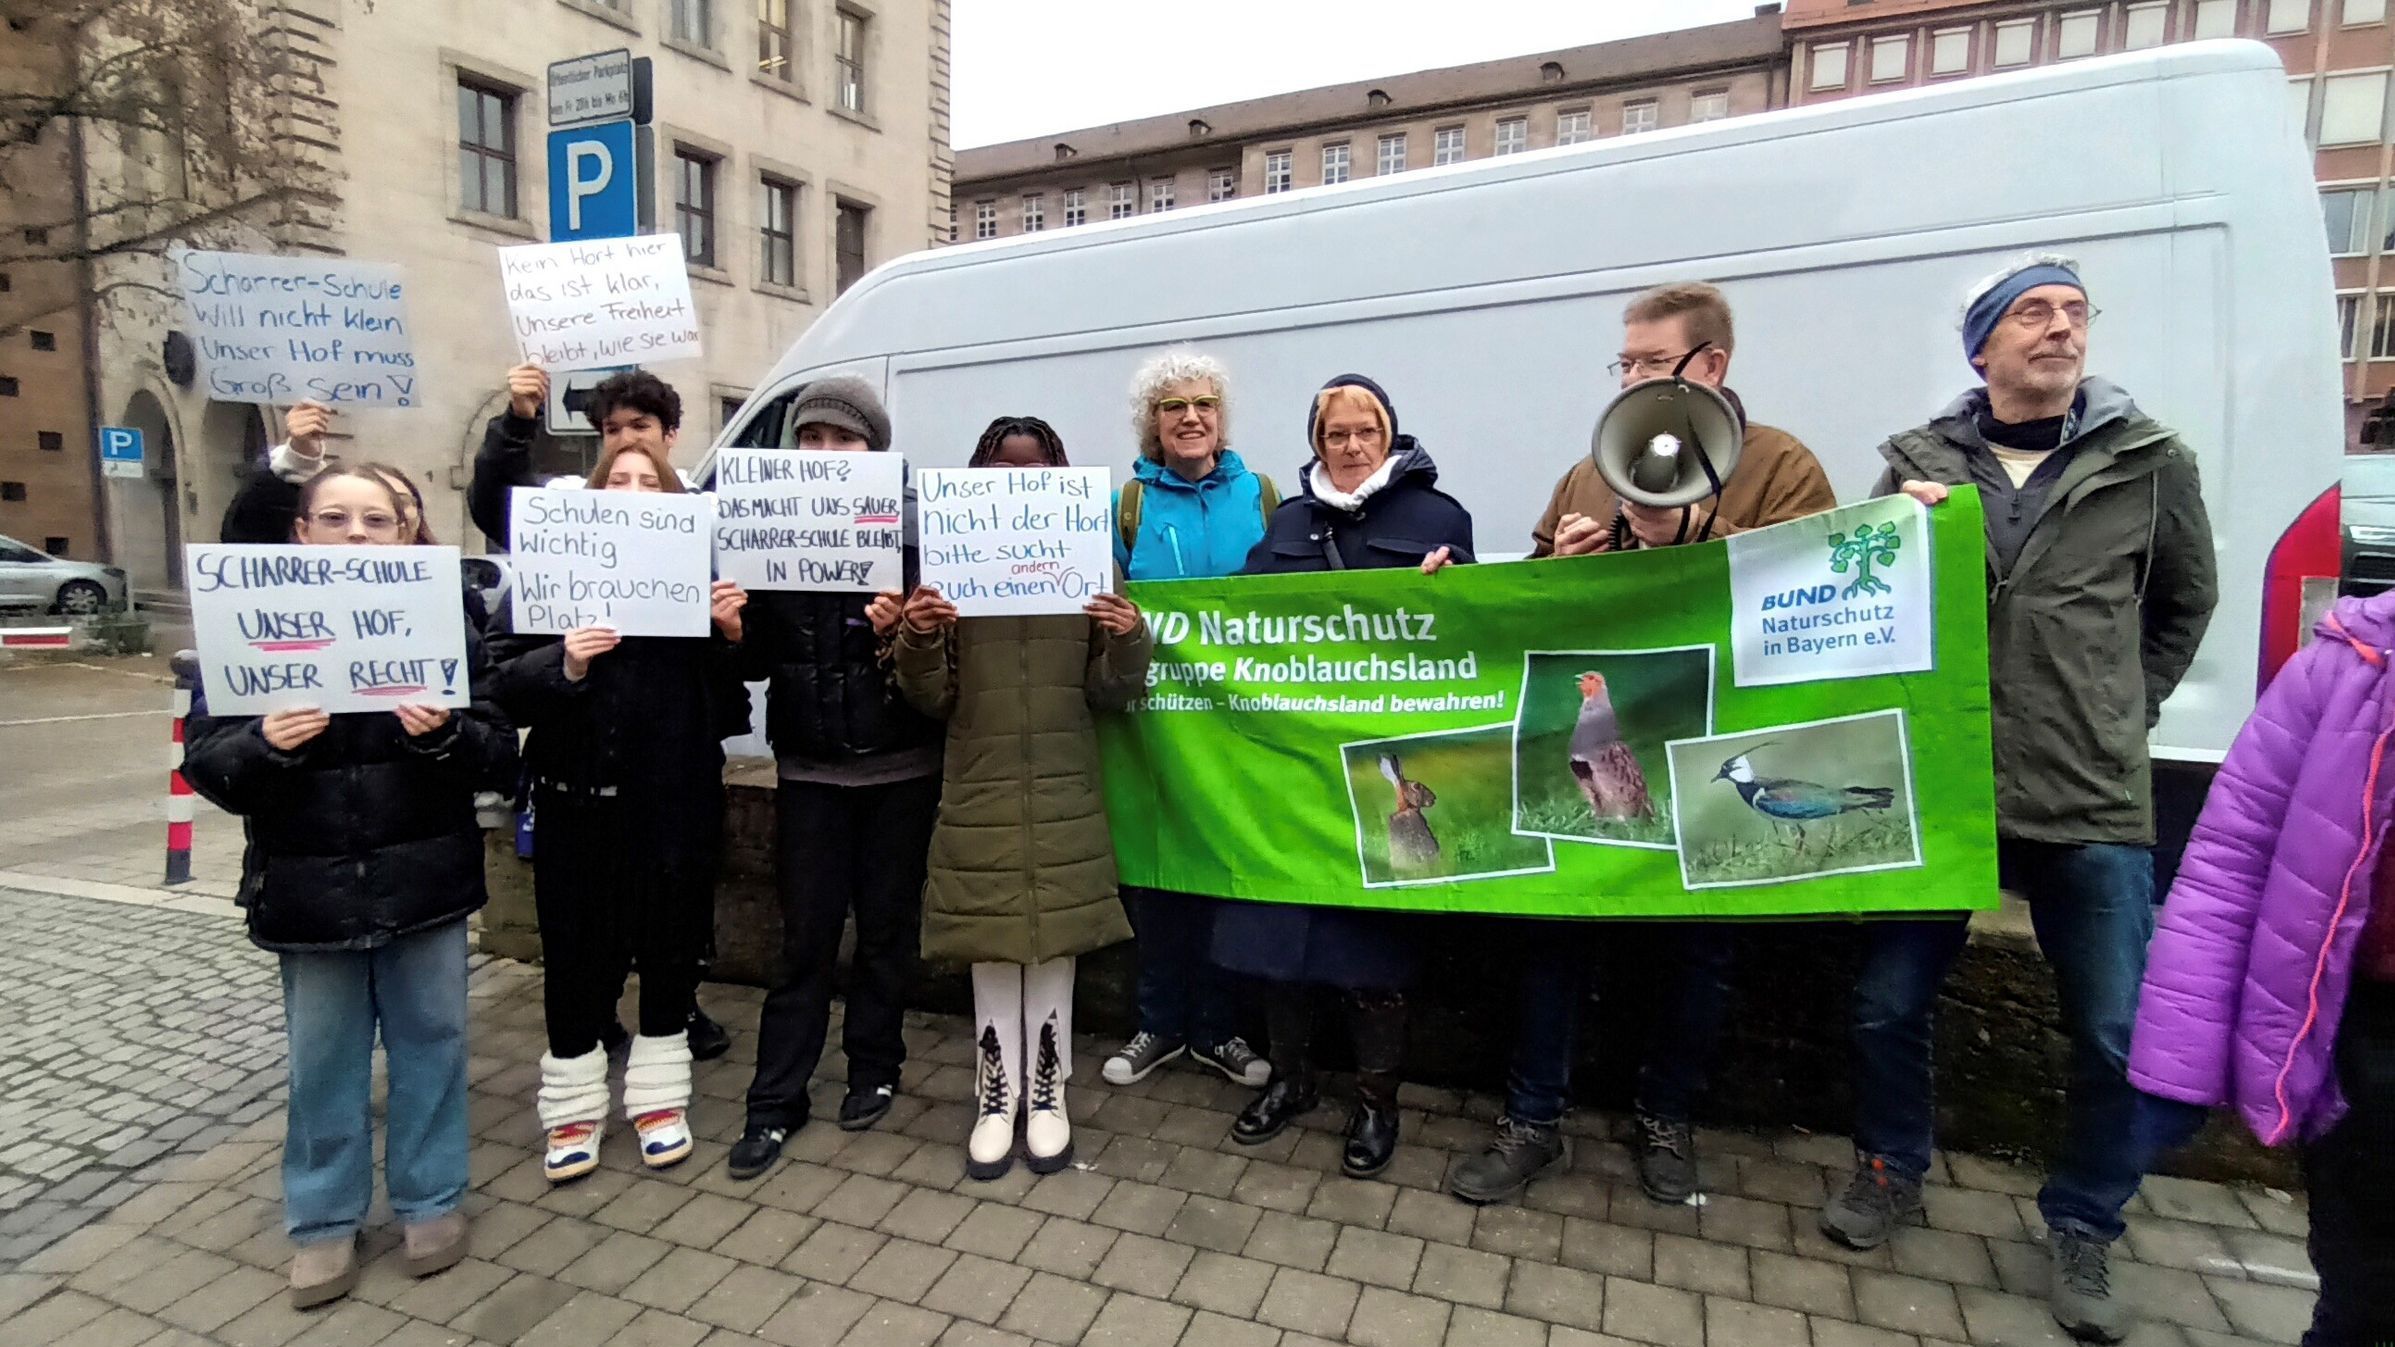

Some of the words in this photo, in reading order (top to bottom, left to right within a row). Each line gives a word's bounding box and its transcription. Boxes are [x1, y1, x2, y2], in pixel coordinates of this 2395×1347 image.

[566, 140, 613, 230] P
[570, 246, 614, 266] Hort
[626, 242, 666, 257] hier
[183, 252, 402, 299] Scharrer-Schule
[510, 283, 552, 301] das
[606, 273, 660, 294] klar,
[260, 300, 331, 328] nicht
[515, 311, 596, 337] Unsere
[600, 298, 685, 320] Freiheit
[200, 335, 278, 361] Unser
[288, 338, 343, 363] Hof
[354, 350, 415, 368] muss
[210, 366, 292, 398] Groß
[109, 431, 132, 456] P
[721, 456, 795, 485] KLEINER
[799, 459, 852, 482] HOF?
[922, 471, 996, 502] Unser
[1008, 471, 1052, 495] Hof
[1059, 475, 1093, 499] ist
[523, 496, 629, 526] Schulen
[639, 507, 695, 533] sind
[718, 498, 750, 519] DAS
[752, 496, 803, 519] MACHT
[811, 496, 851, 517] UNS
[924, 503, 1002, 536] nicht
[1012, 503, 1058, 531] der
[1065, 503, 1109, 533] Hort
[717, 526, 851, 551] SCHARRER-SCHULE
[923, 543, 991, 567] bitte
[996, 539, 1072, 561] sucht
[196, 552, 432, 592] SCHARRER-SCHULE
[766, 558, 787, 582] IN
[799, 558, 874, 586] POWER!
[1011, 560, 1060, 575] andern
[519, 572, 561, 602] Wir
[569, 570, 700, 604] brauchen
[994, 577, 1057, 599] einen
[1062, 571, 1109, 599] Ort
[1761, 584, 1837, 611] BUND
[236, 608, 336, 640] UNSER
[1141, 611, 1190, 645] ND
[1198, 603, 1438, 646] Naturschutz
[1762, 604, 1895, 635] Naturschutz
[1764, 640, 1782, 656] in
[1787, 632, 1858, 655] Bayern
[1864, 626, 1896, 646] e.V.
[224, 663, 323, 696] UNSER
[1144, 660, 1226, 687] gruppe
[1233, 650, 1478, 684] Knoblauchsland
[1140, 692, 1213, 711] schützen
[1228, 692, 1385, 714] Knoblauchsland
[1389, 690, 1505, 713] bewahren!
